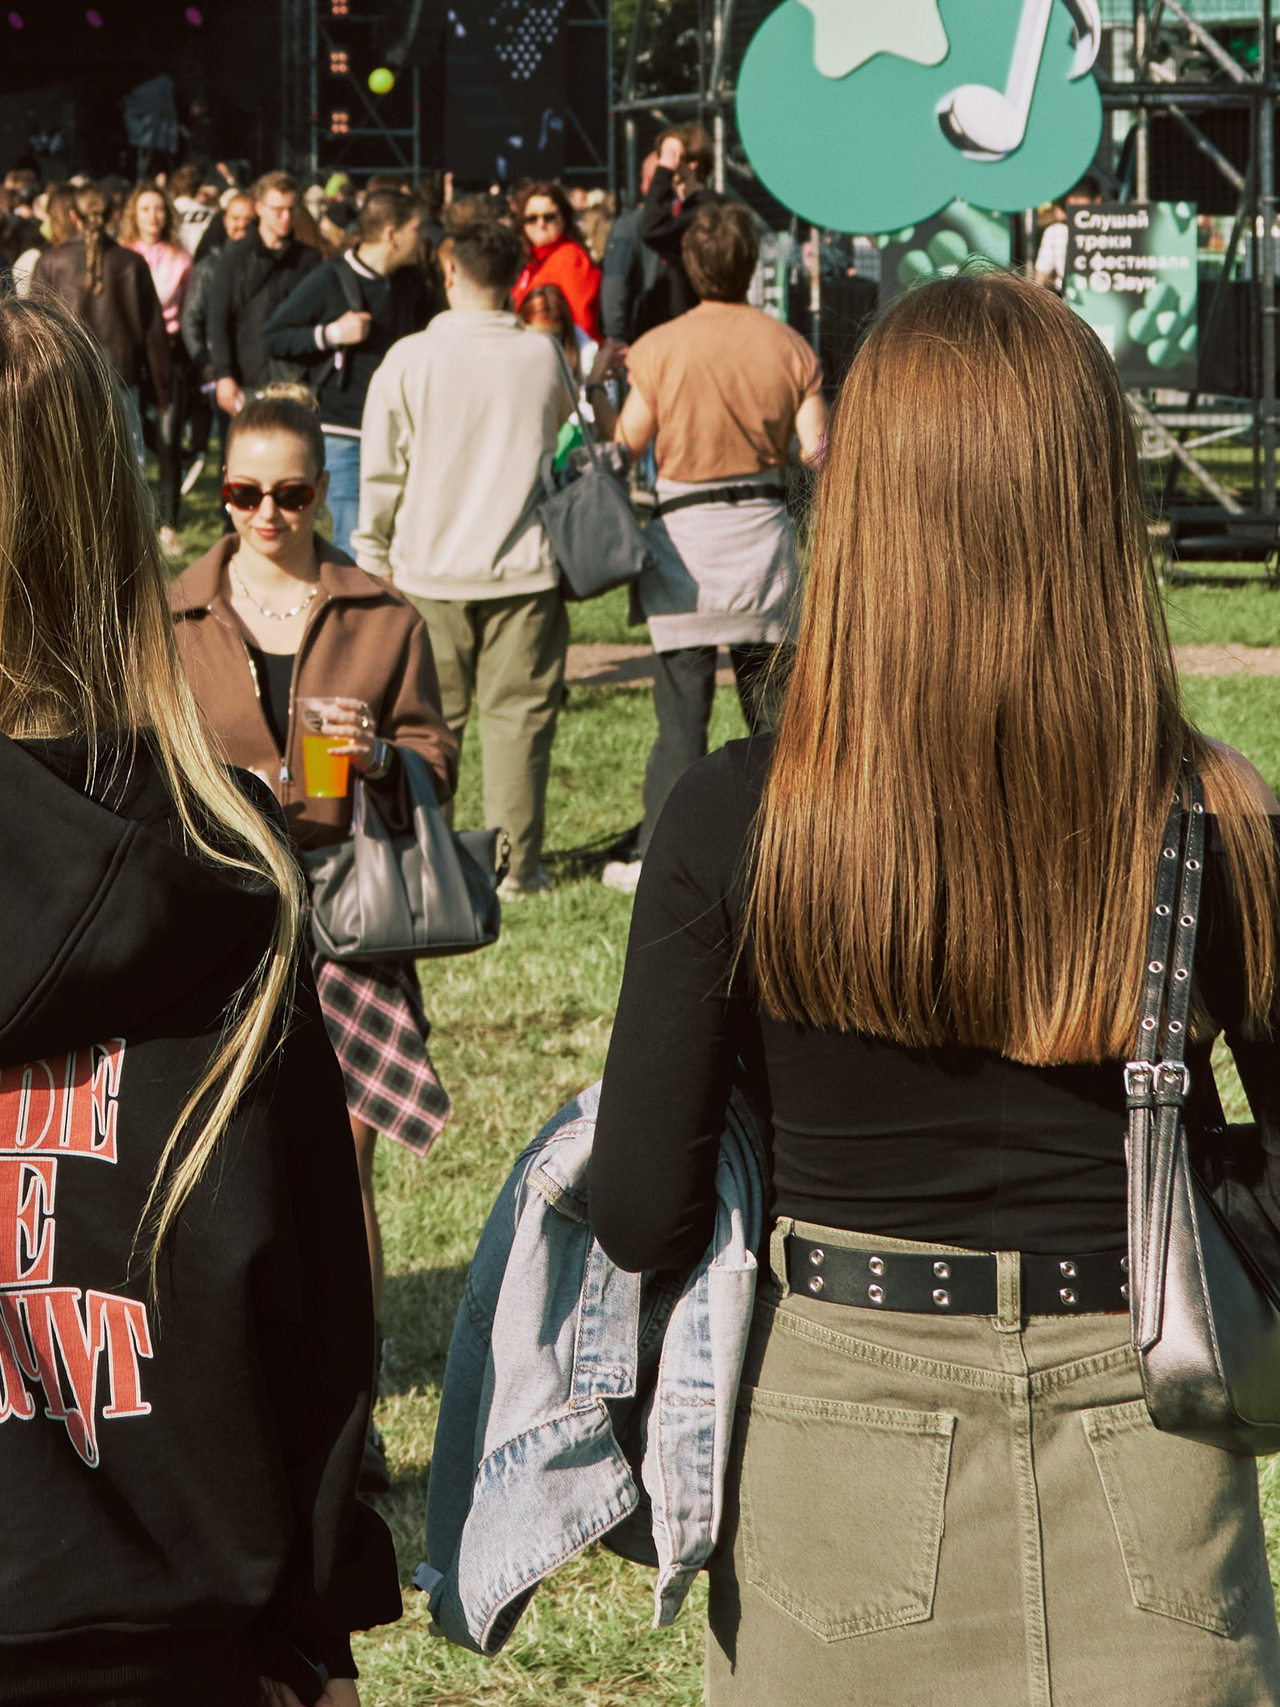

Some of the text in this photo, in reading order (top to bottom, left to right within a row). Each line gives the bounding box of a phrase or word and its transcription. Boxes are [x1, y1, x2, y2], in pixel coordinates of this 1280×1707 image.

[1074, 209, 1150, 232] Слушай
[1074, 234, 1132, 252] треки
[1074, 252, 1190, 272] с фестиваля
[1112, 273, 1158, 294] Звук
